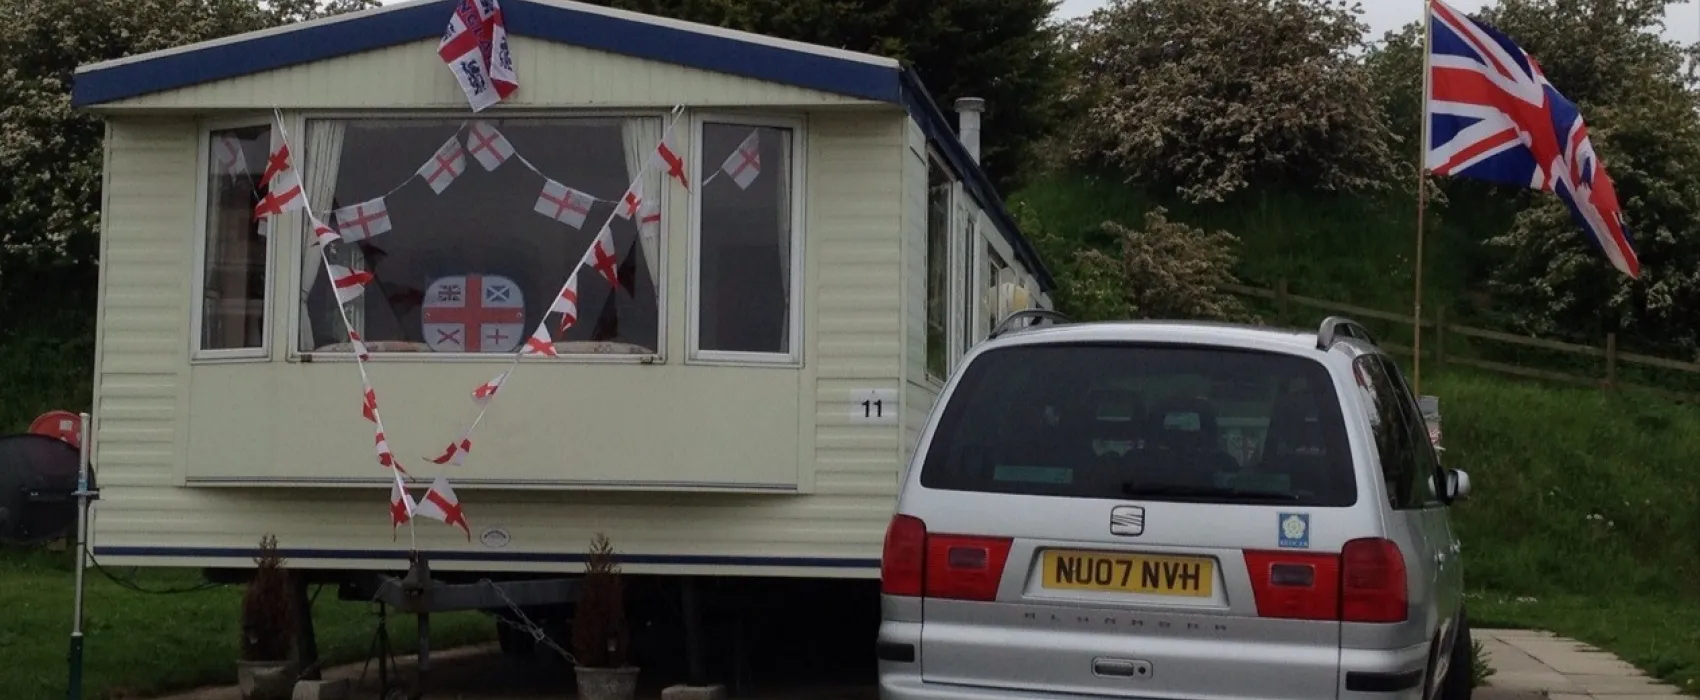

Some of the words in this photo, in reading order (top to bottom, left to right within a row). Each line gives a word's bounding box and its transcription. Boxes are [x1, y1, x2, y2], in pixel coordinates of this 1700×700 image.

[862, 399, 882, 418] 11
[1055, 555, 1134, 587] NU07
[1141, 560, 1201, 591] NVH
